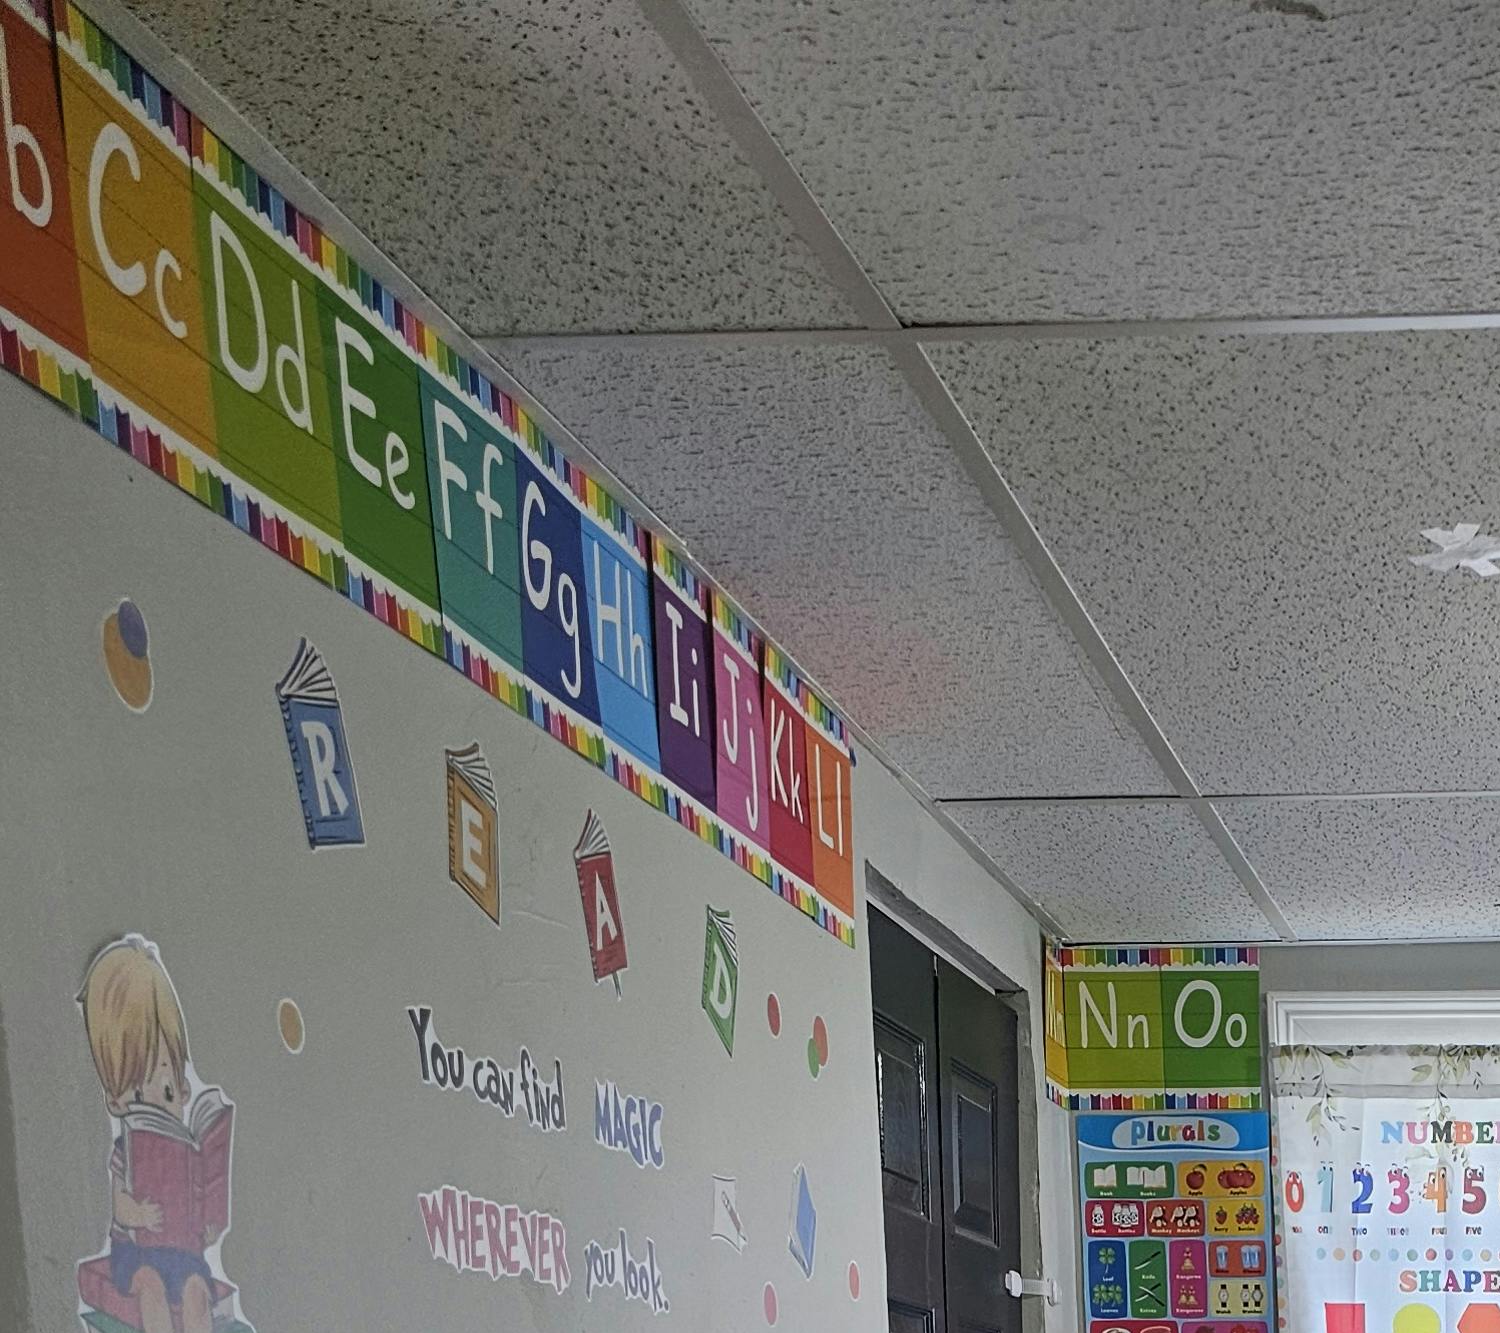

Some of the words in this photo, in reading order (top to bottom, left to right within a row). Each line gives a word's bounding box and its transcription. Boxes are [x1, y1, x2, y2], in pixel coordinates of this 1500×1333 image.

[88, 121, 188, 339] Cc
[211, 211, 314, 437] Dd
[336, 316, 415, 509] Ee
[434, 399, 504, 574] Ff
[521, 481, 582, 699] Gg
[593, 540, 649, 697] Hh
[665, 600, 702, 737] Ii
[722, 663, 760, 831] Jj
[769, 723, 804, 824] Kk
[1078, 980, 1149, 1048] Nn
[1174, 979, 1247, 1048] Oo
[408, 1007, 465, 1088] You
[473, 1058, 514, 1116] can
[520, 1048, 566, 1131] find
[594, 1081, 664, 1168] MAGIC
[418, 1187, 571, 1294] WHEREVER
[584, 1242, 615, 1300] you
[1351, 1165, 1375, 1214] 2
[1387, 1166, 1411, 1215] 3
[1461, 1166, 1487, 1215] 5
